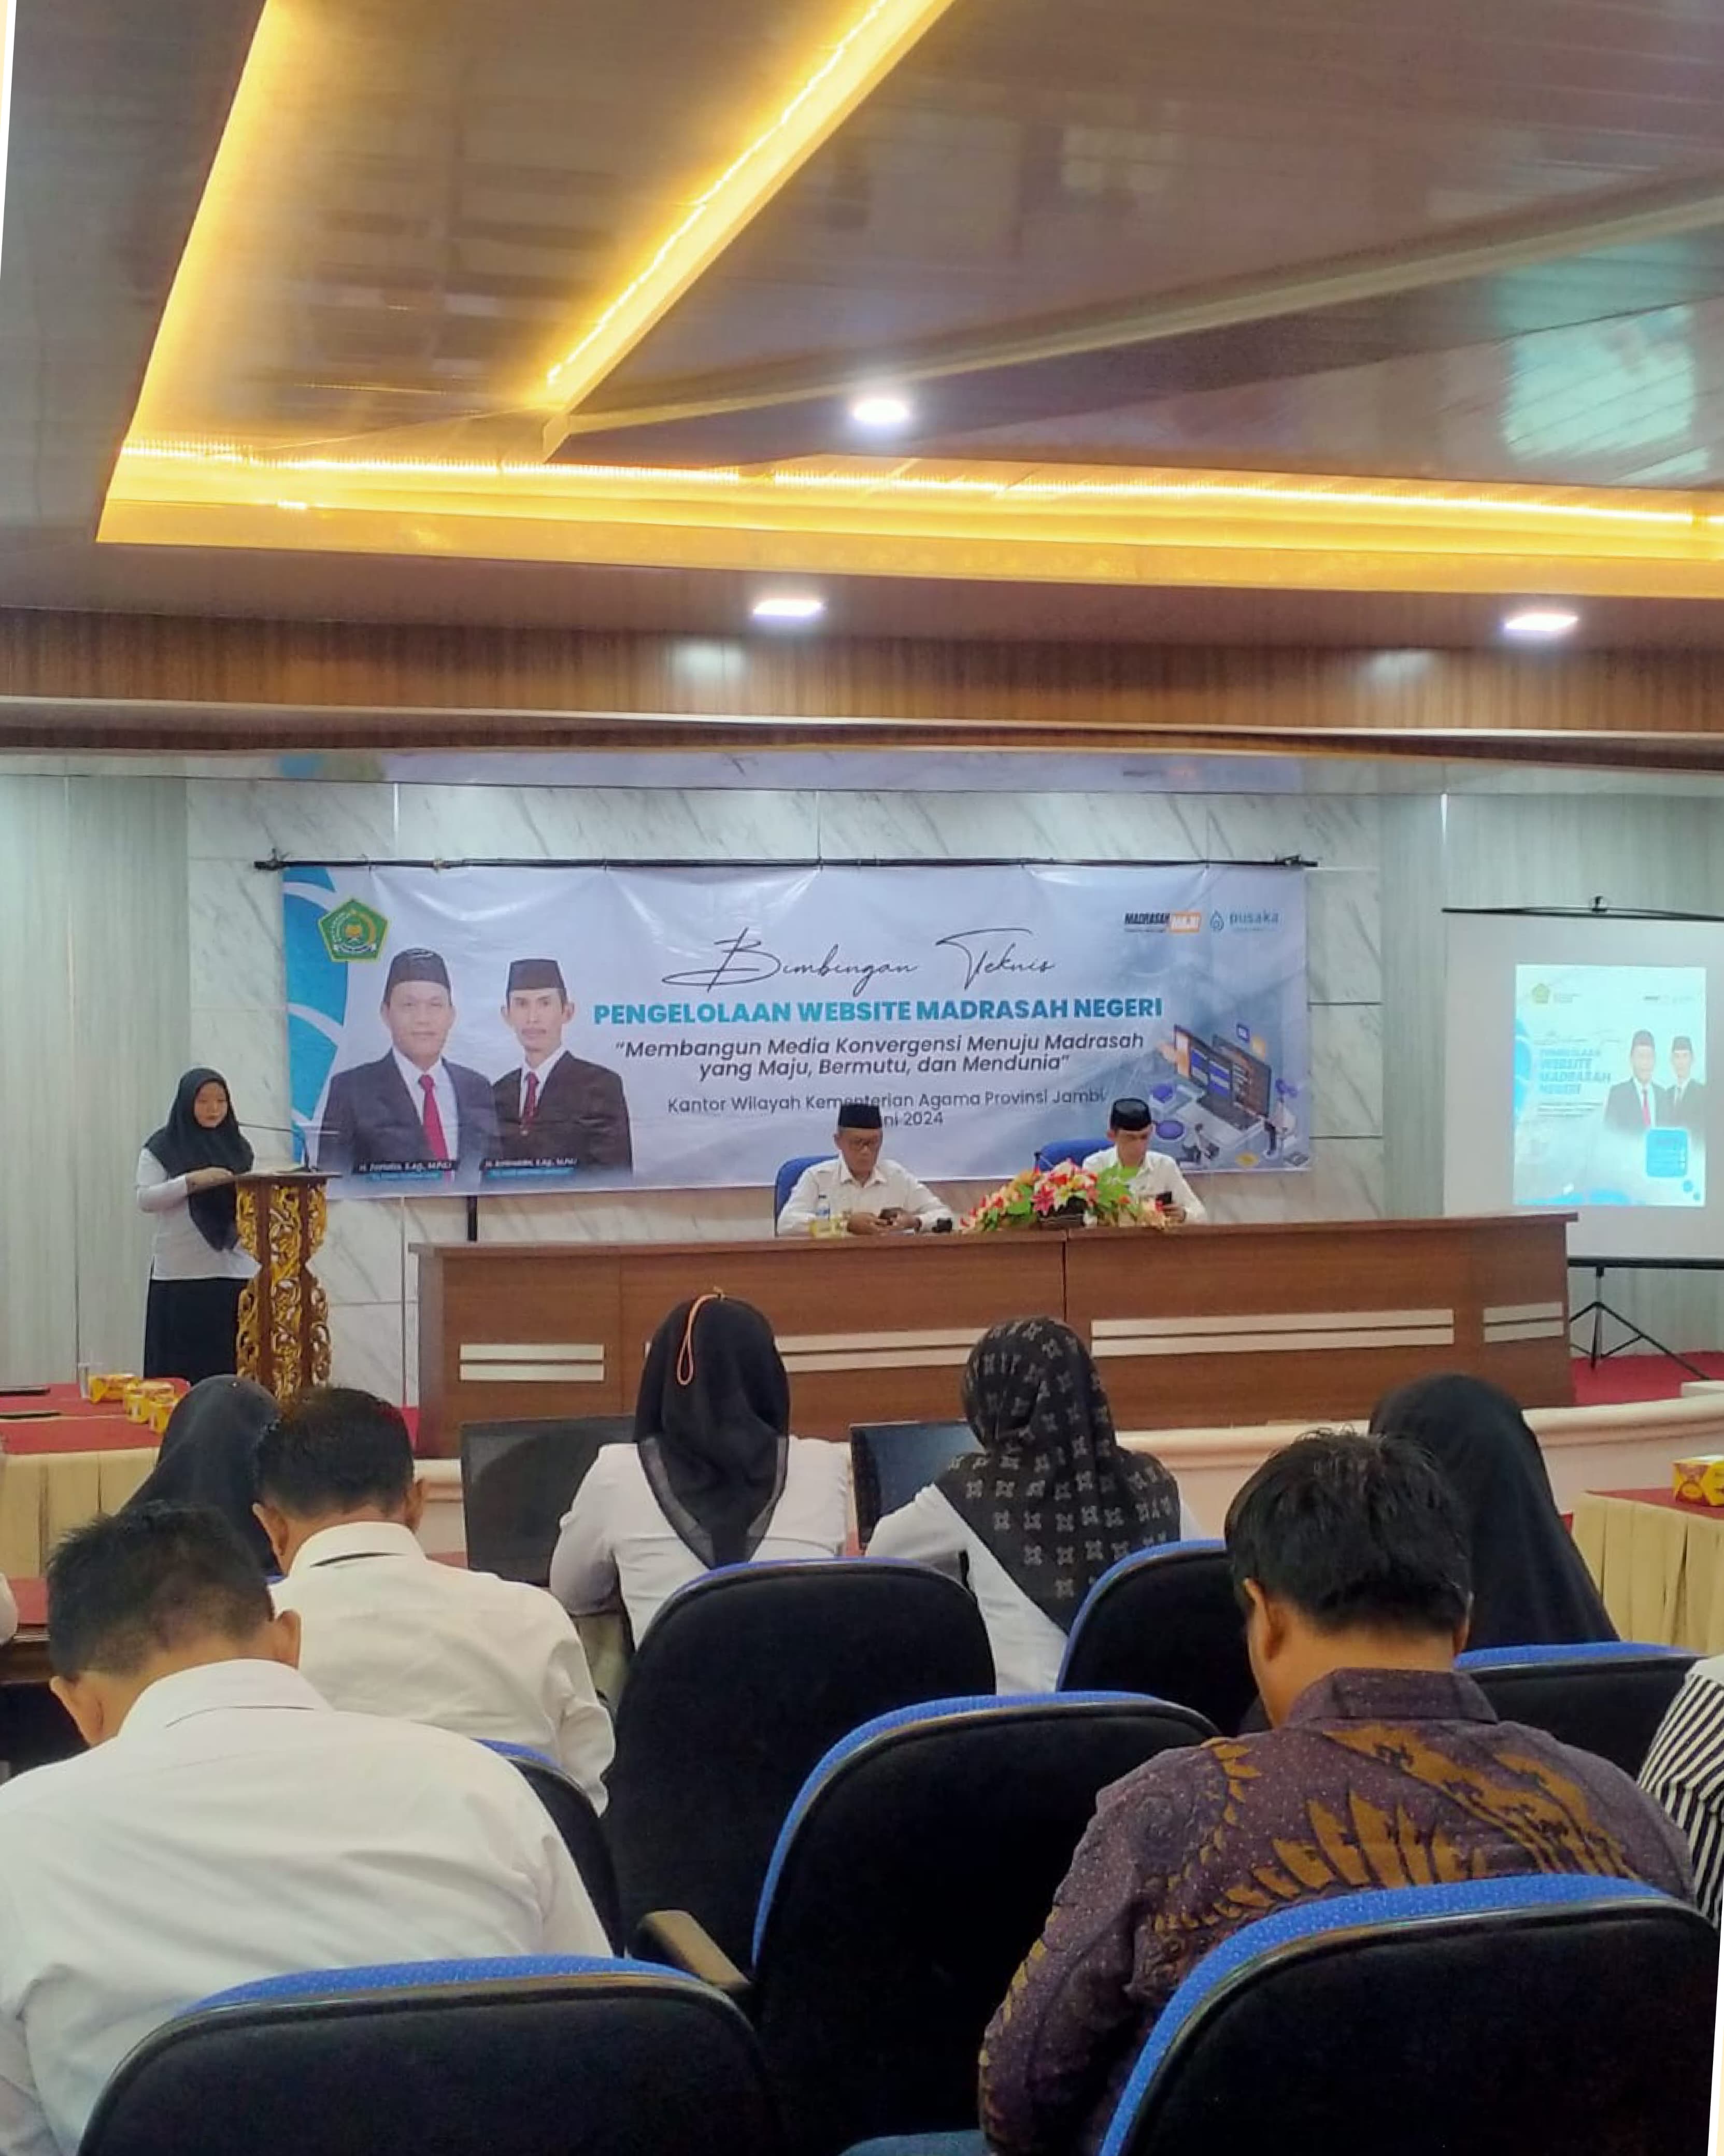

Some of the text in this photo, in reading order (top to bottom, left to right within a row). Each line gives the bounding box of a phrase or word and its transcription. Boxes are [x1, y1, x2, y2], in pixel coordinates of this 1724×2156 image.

[661, 926, 1057, 998] Bimbingan Teknis
[594, 997, 1163, 1025] PENGELOLAAN WEBSITE MADRASAH NEGERI
[767, 1037, 830, 1054] Media
[836, 1035, 962, 1057] Konvergensi
[967, 1034, 1041, 1055] Menuju
[1045, 1033, 1144, 1049] Madrasah
[700, 1060, 752, 1082] yang
[758, 1057, 813, 1080] Maju,
[819, 1058, 910, 1076] Bermutu,
[917, 1056, 956, 1073] dan
[668, 1098, 726, 1113] Kantor
[732, 1096, 801, 1114] Wilayah
[919, 1092, 980, 1110] Agama
[985, 1089, 1047, 1105] Provinsi
[903, 1111, 944, 1126] 2024
